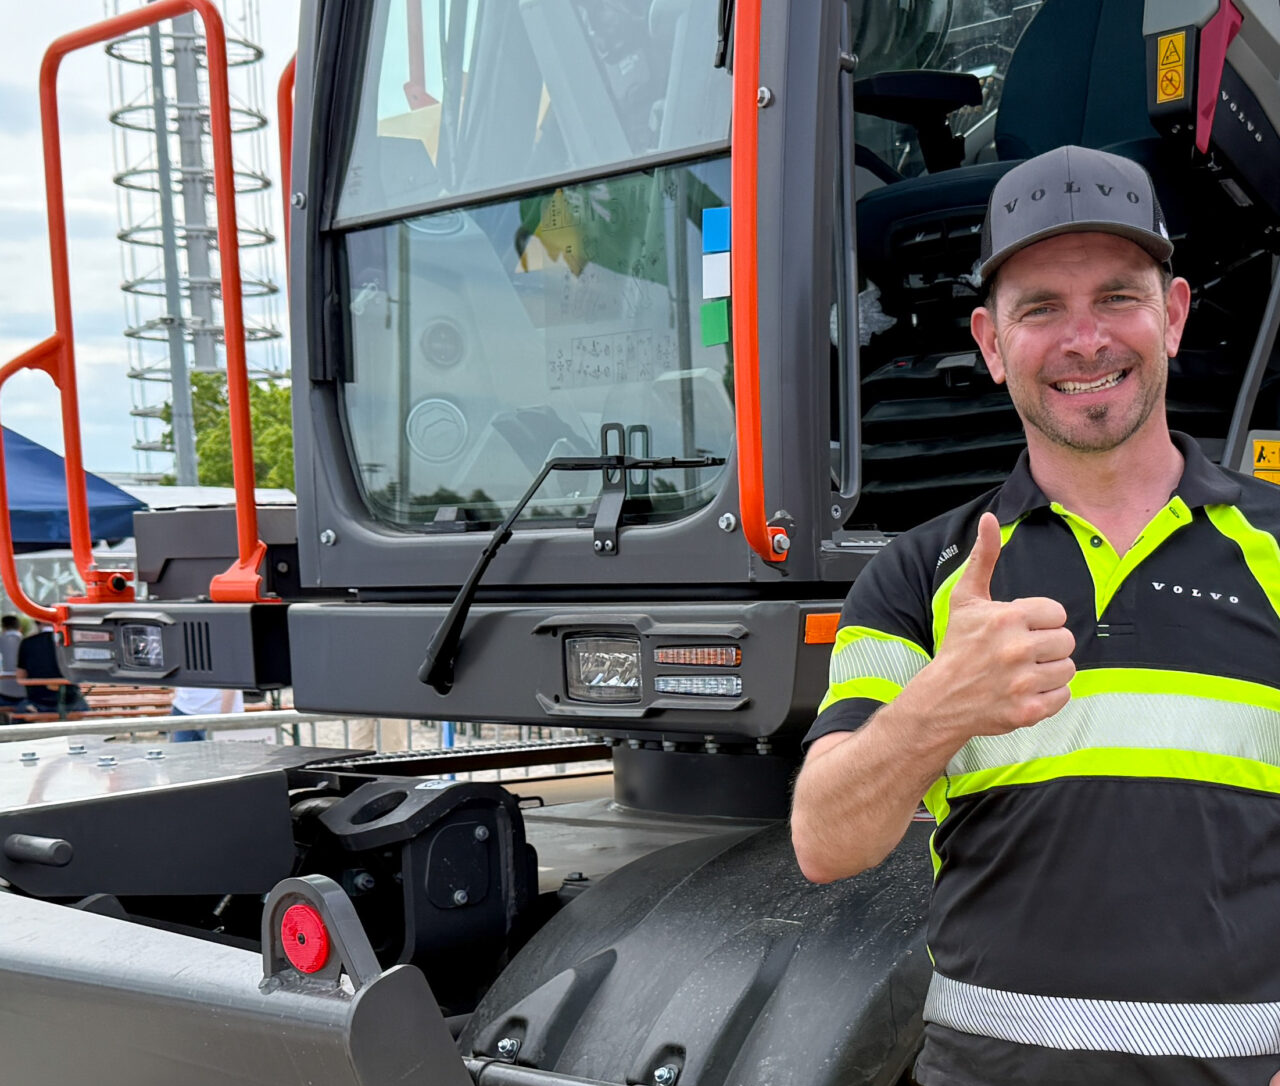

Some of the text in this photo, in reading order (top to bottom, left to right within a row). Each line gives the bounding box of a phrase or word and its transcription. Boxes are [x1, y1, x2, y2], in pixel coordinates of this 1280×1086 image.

[1222, 90, 1262, 142] VOLVO
[1003, 180, 1140, 214] VOLVO
[1151, 581, 1239, 604] VOLVO
